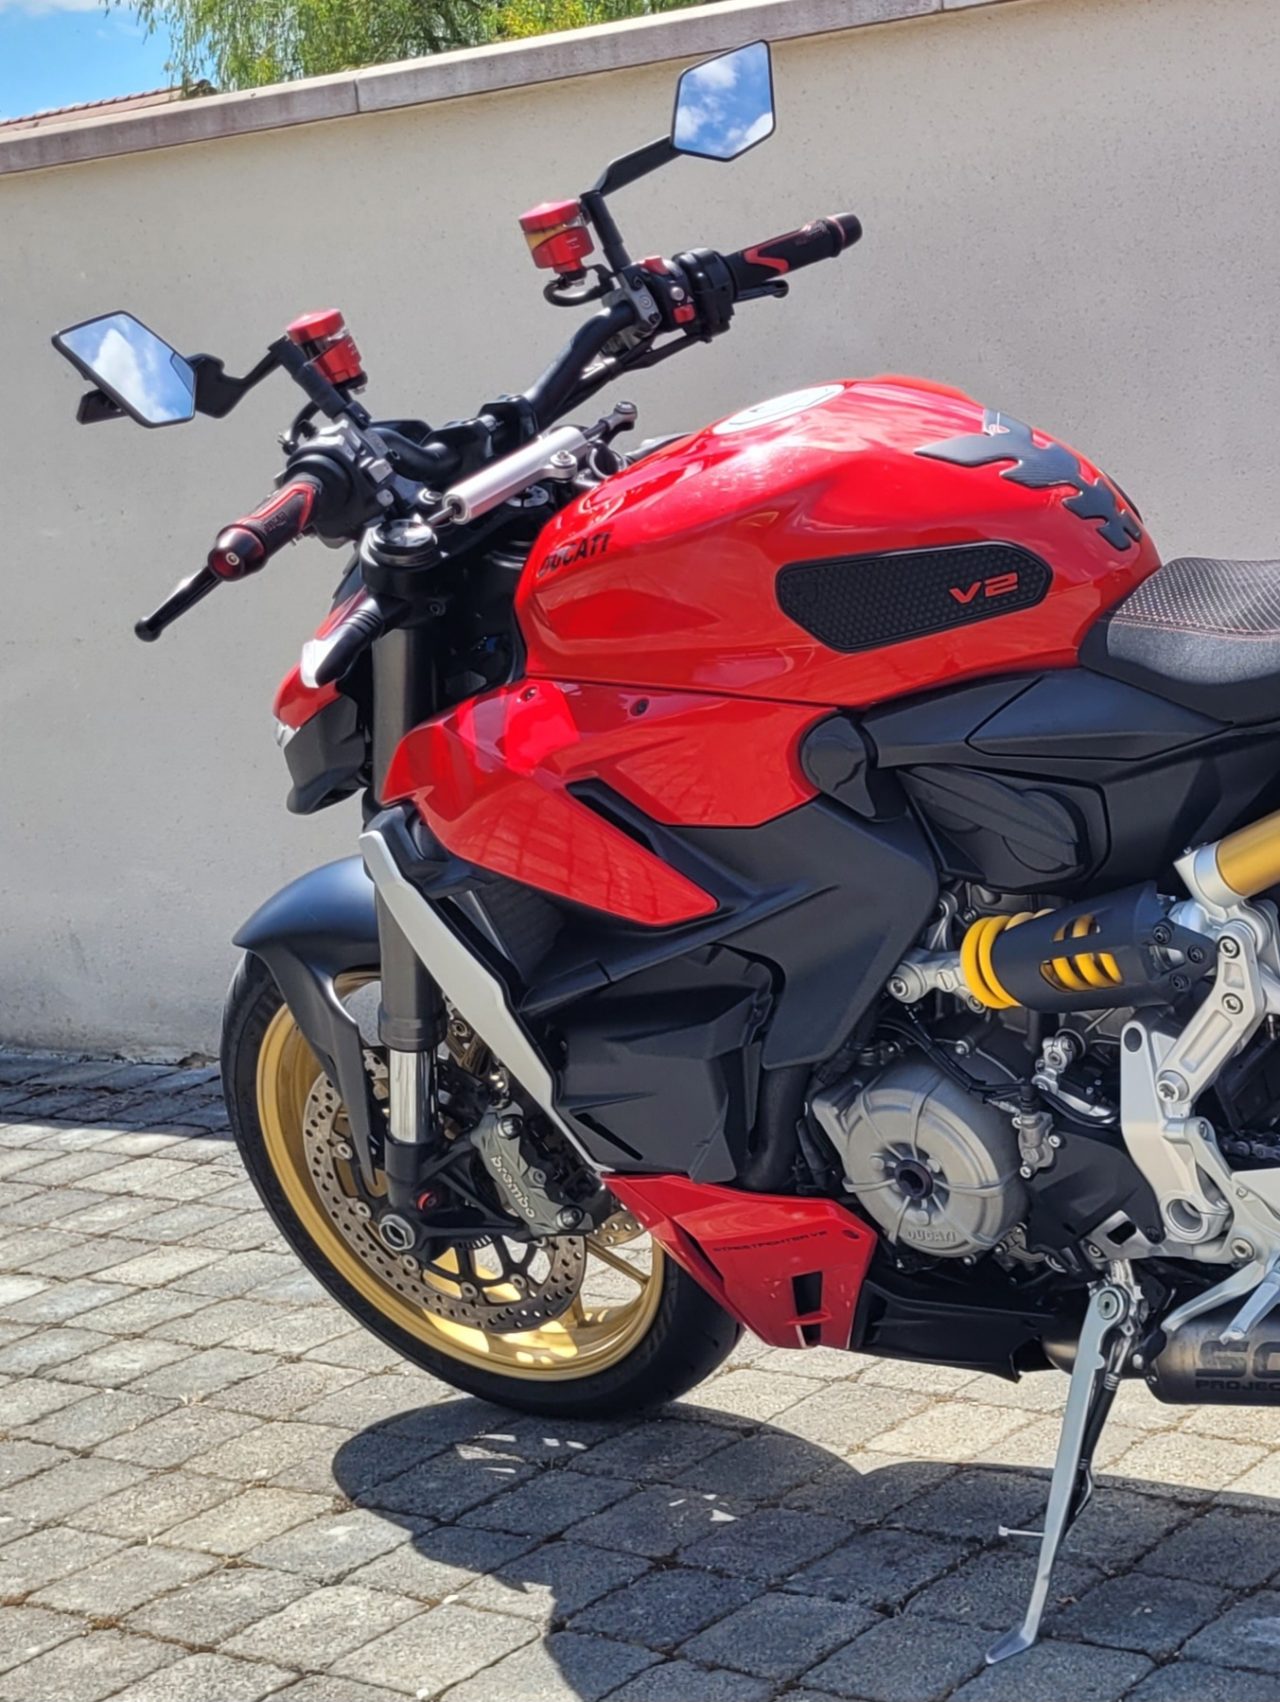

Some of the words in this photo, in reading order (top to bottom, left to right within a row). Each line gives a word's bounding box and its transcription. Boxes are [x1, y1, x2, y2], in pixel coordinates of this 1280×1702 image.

[538, 531, 612, 577] DUCATI
[949, 572, 1018, 604] V2
[491, 1156, 535, 1218] brembo
